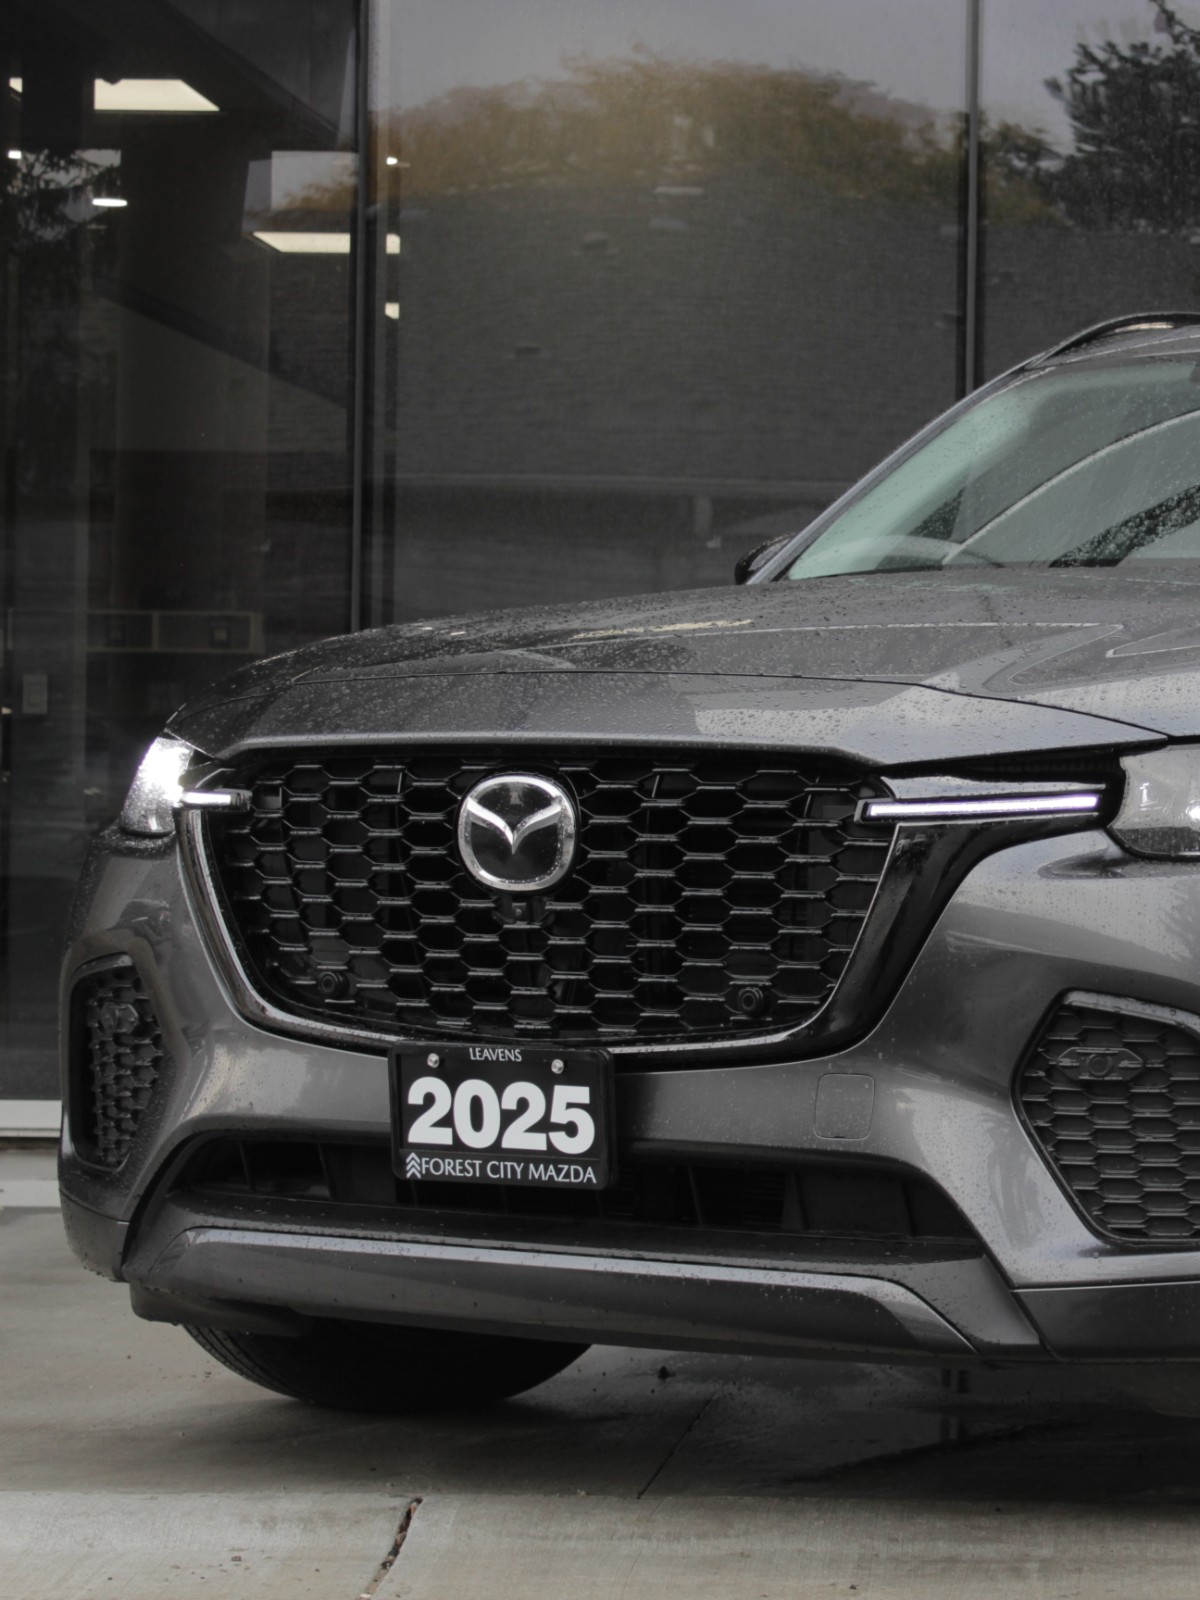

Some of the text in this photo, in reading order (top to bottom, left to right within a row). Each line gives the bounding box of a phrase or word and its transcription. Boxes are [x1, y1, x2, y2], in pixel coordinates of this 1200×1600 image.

[469, 1048, 522, 1062] LEAVENS
[408, 1076, 595, 1155] 2025
[421, 1157, 597, 1184] FOREST CITY MAZDA
